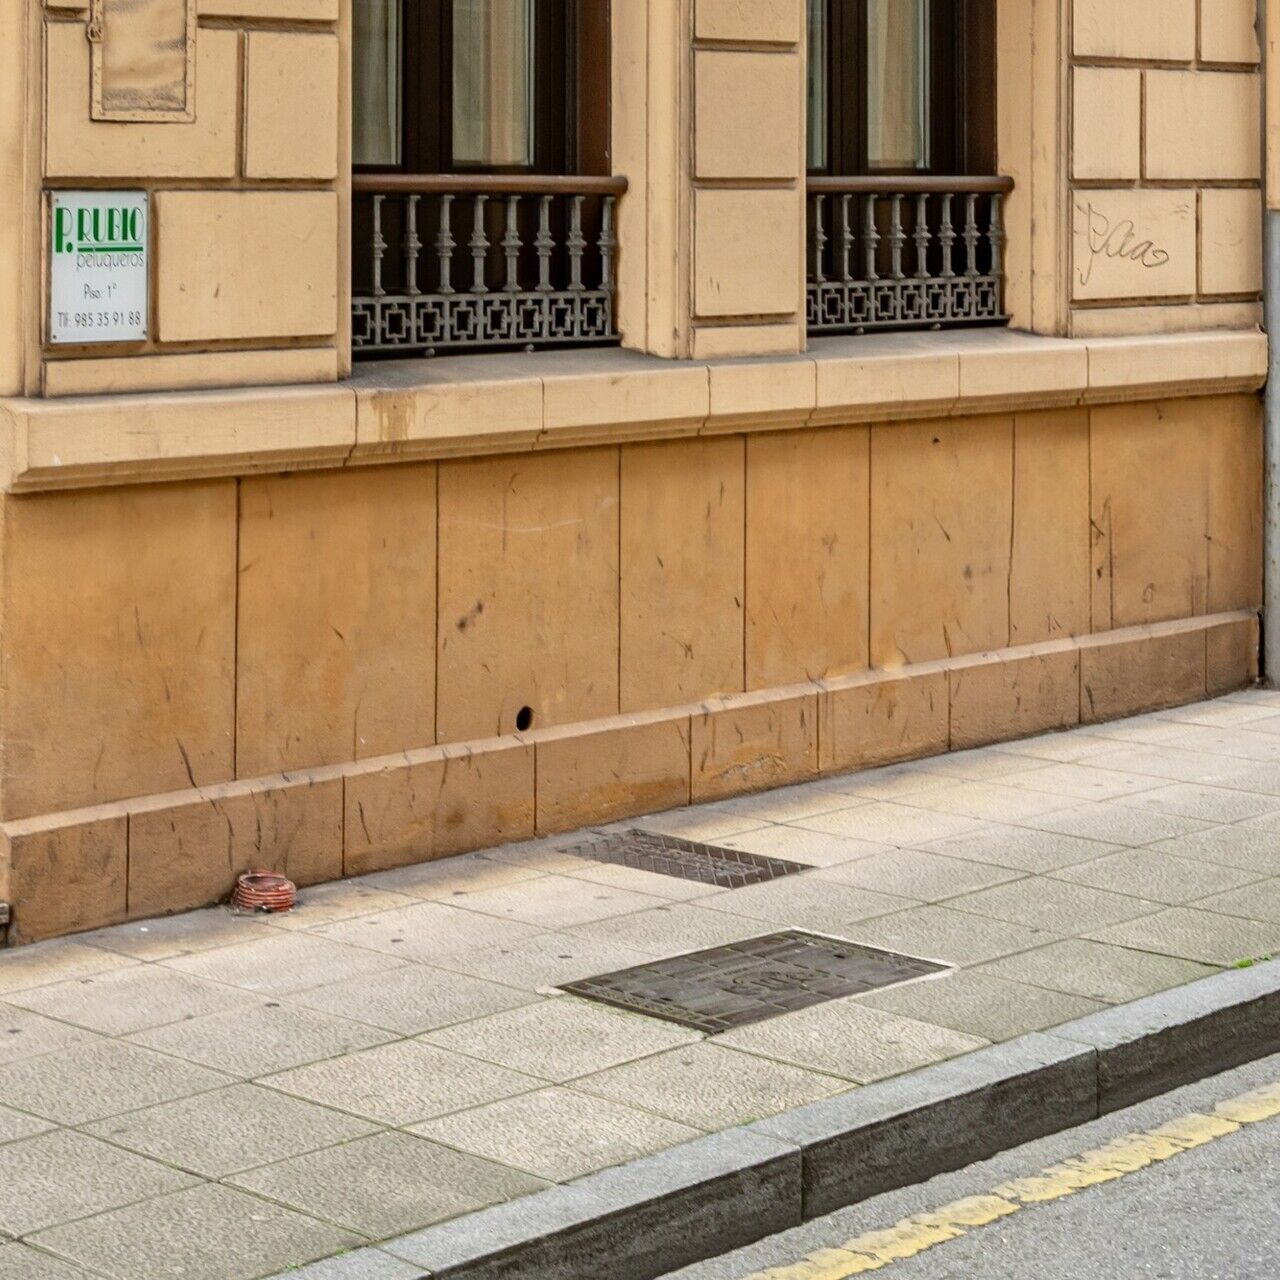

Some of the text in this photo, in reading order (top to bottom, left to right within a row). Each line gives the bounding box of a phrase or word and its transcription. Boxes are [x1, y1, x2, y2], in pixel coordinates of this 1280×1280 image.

[78, 207, 144, 241] RUBIO
[77, 253, 144, 271] peluqueros
[74, 312, 94, 328] 985
[96, 311, 110, 327] 35
[112, 311, 124, 326] 91
